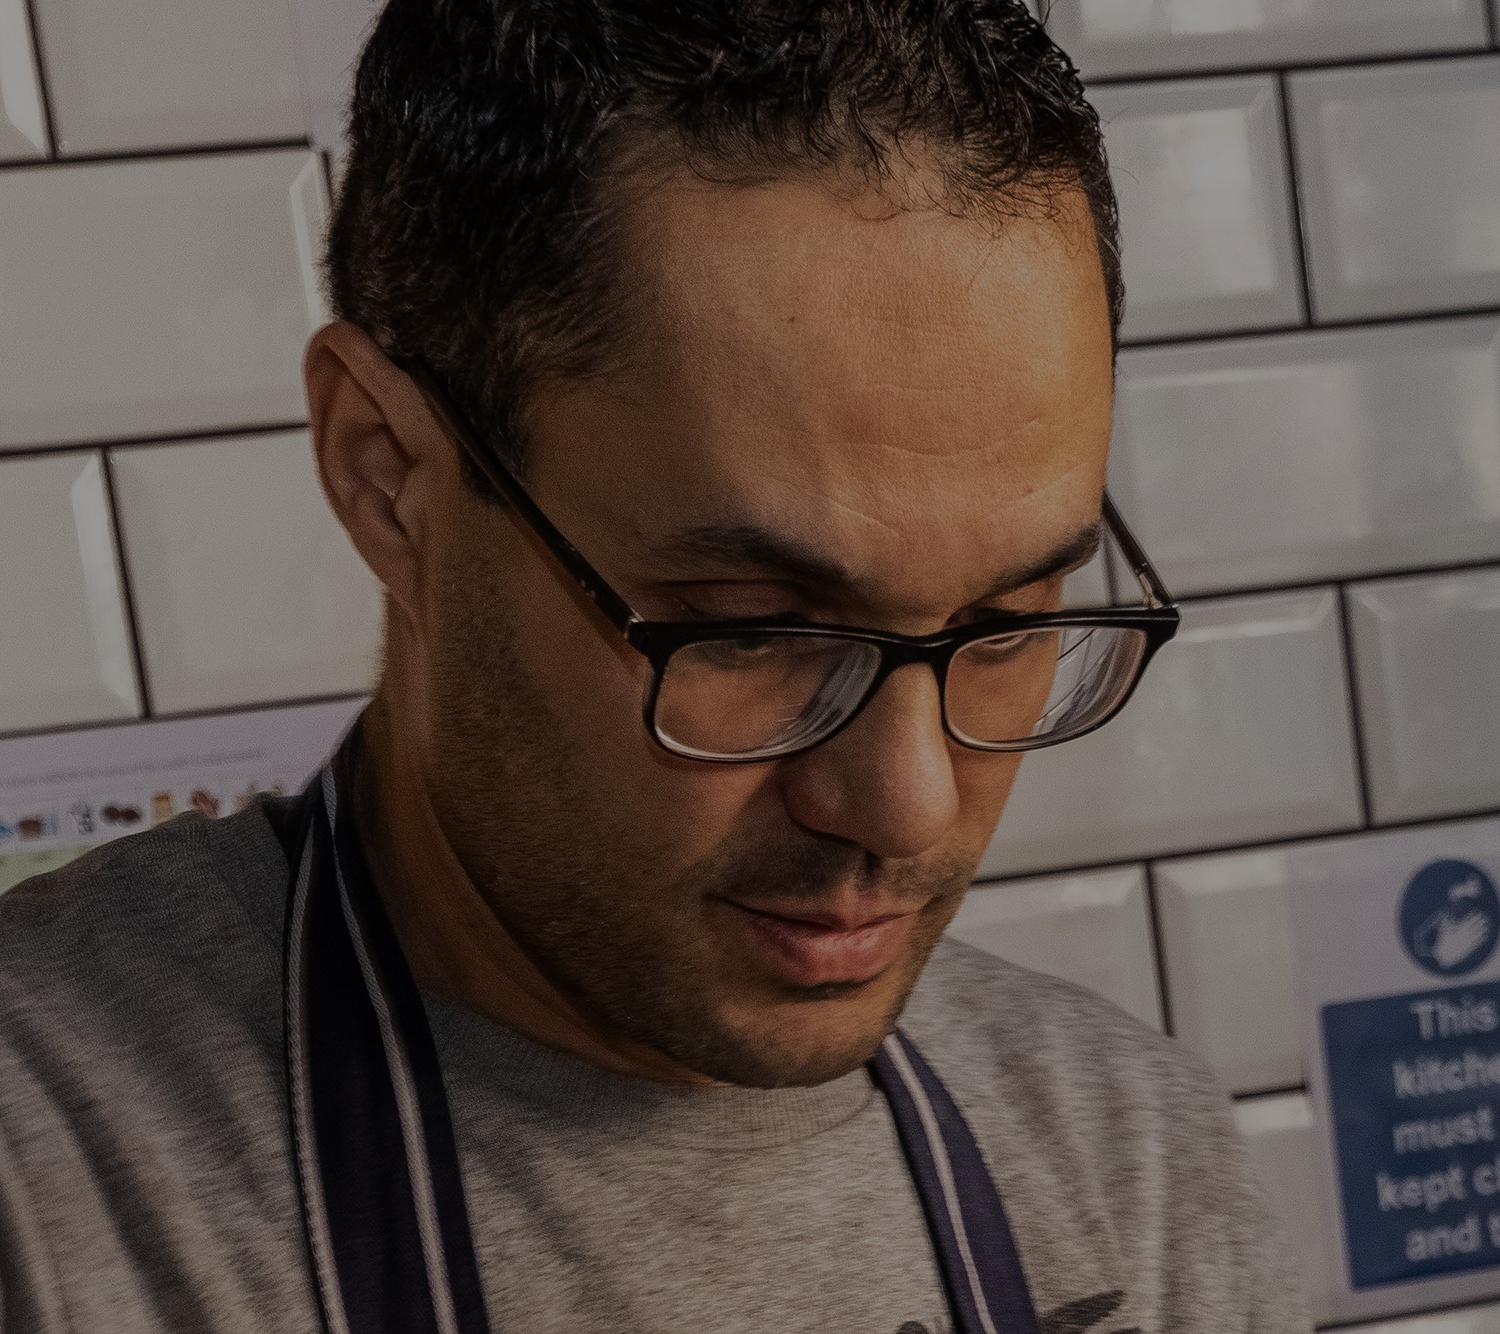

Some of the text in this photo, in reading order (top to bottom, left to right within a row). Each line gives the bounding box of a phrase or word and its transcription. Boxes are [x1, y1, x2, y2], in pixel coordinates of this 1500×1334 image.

[1410, 996, 1498, 1039] This
[1395, 1107, 1494, 1152] must
[1378, 1167, 1466, 1211] kept
[1407, 1213, 1480, 1259] and
